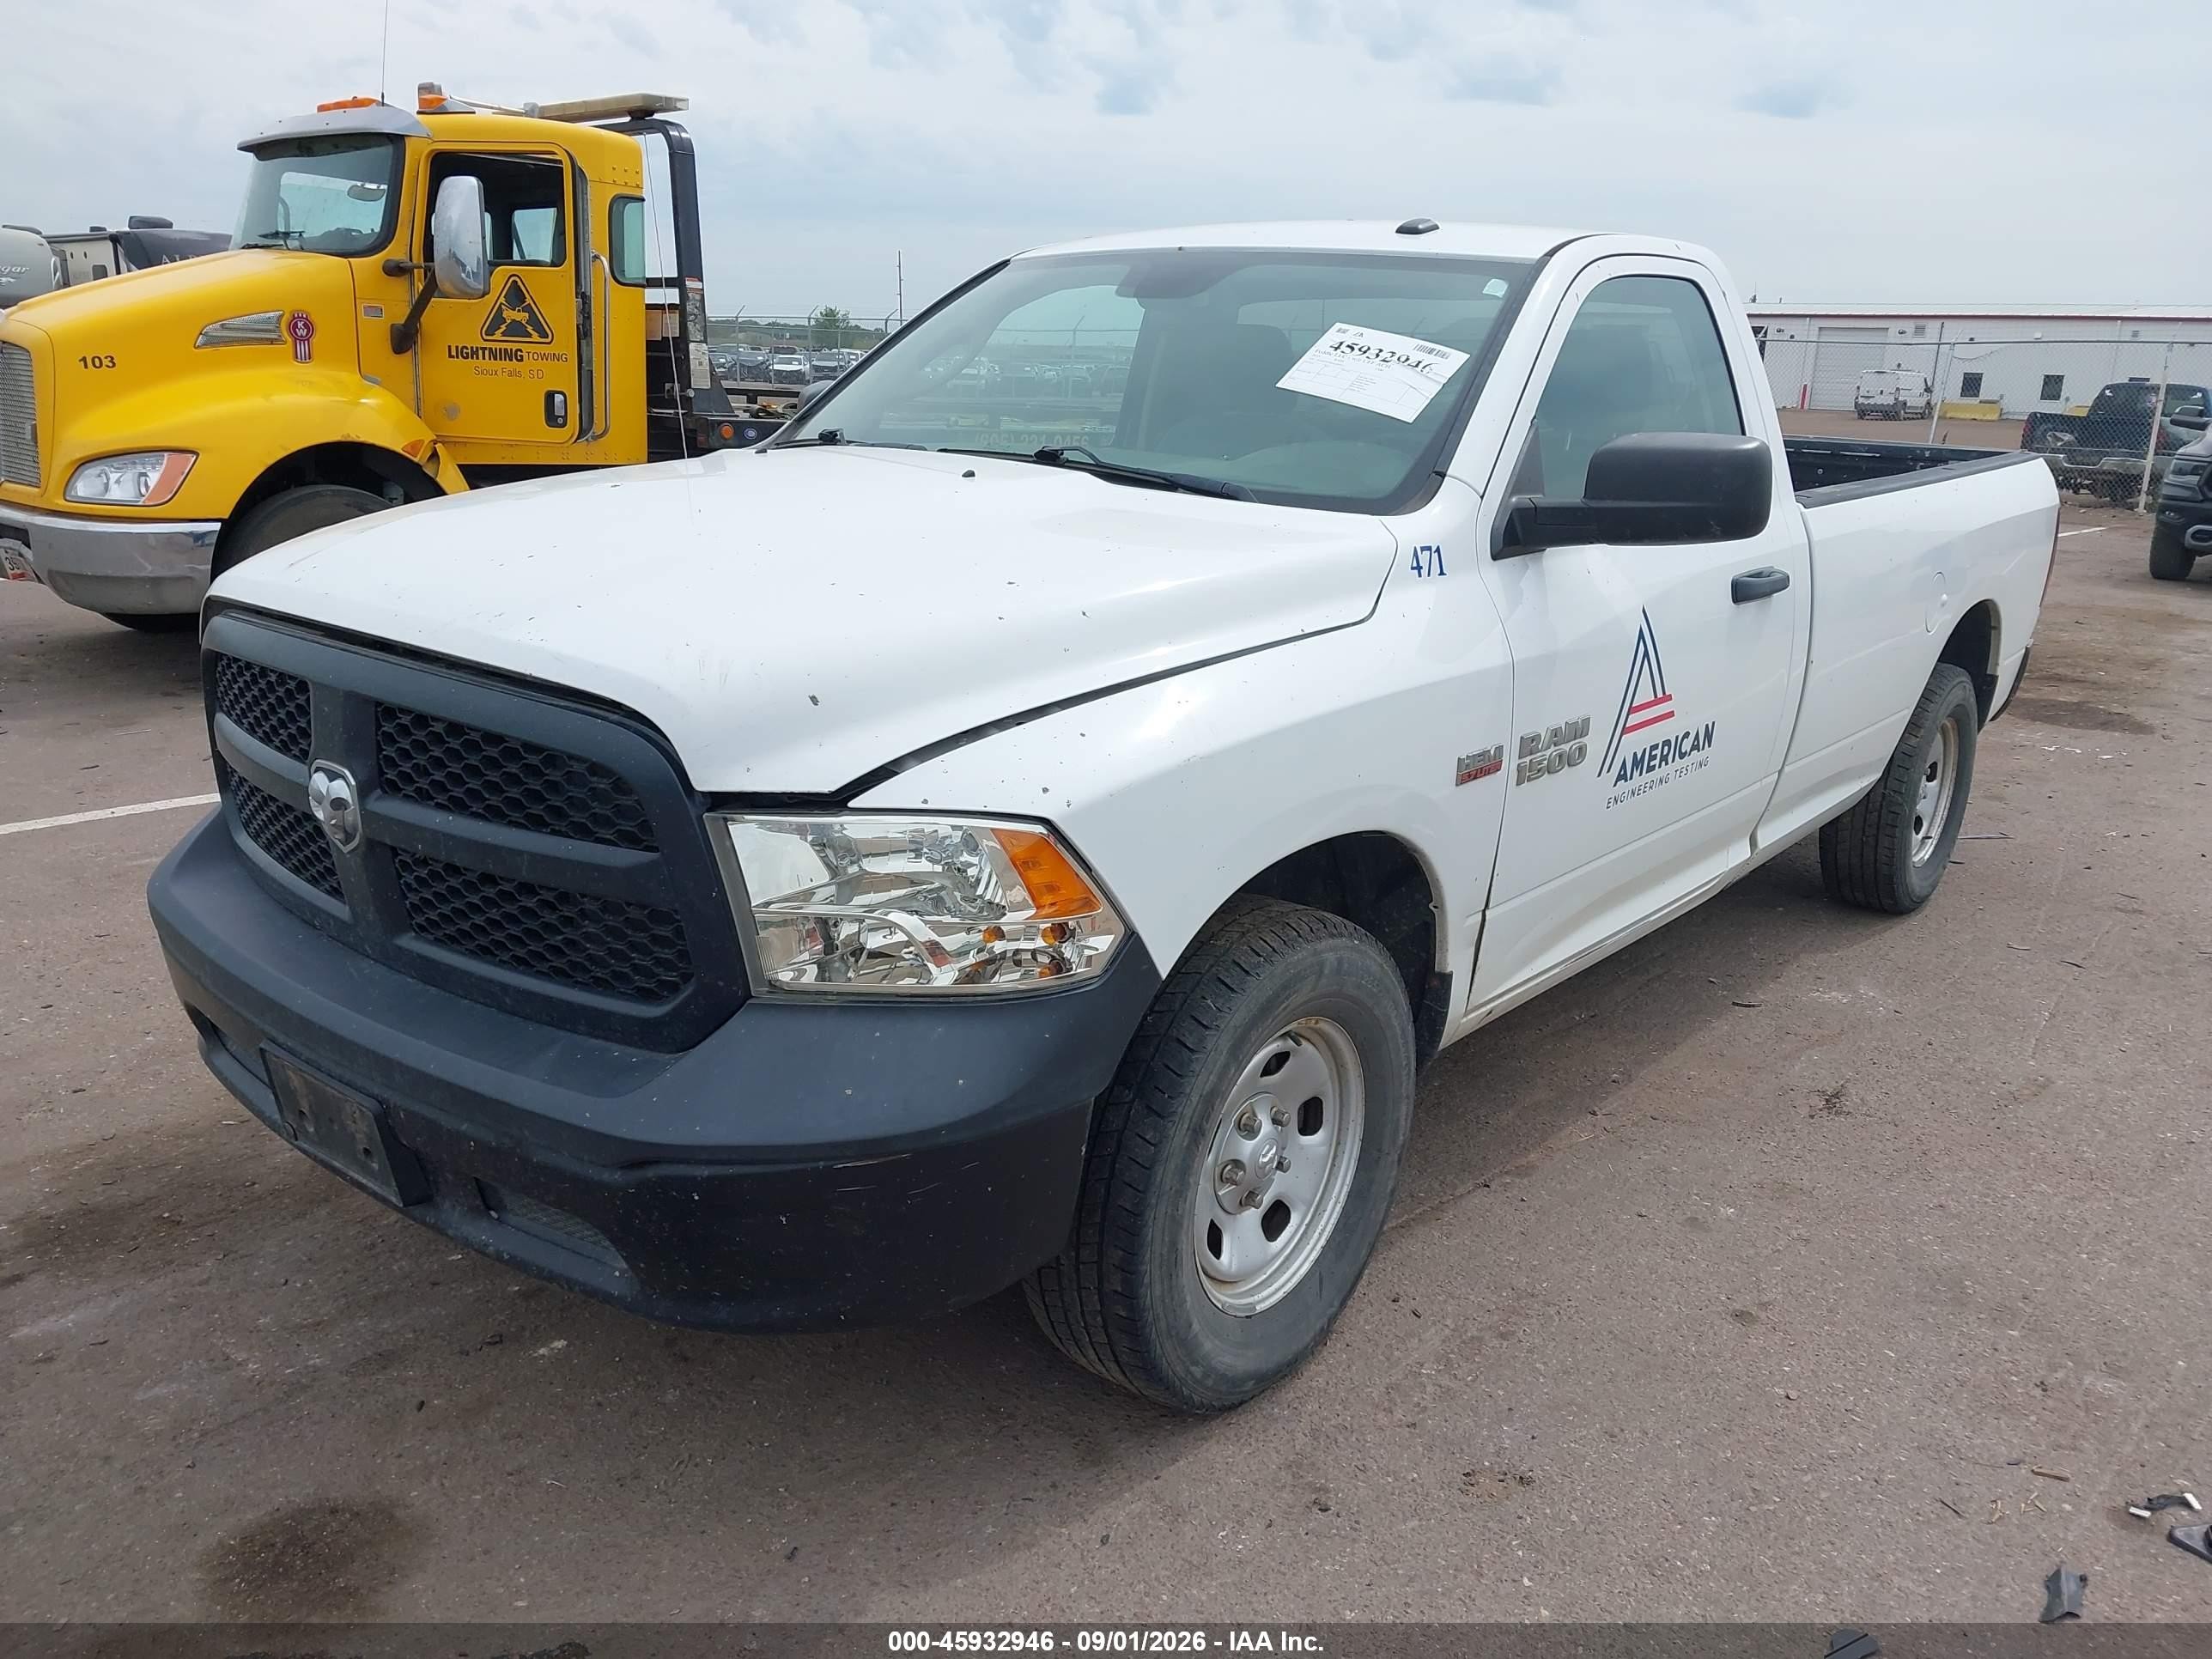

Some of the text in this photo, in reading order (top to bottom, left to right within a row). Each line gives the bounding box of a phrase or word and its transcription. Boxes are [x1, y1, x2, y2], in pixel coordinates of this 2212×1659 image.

[0, 265, 30, 275] gar
[78, 356, 117, 369] 103
[447, 344, 568, 362] LIGHTNING TOWING
[474, 366, 499, 377] Sioux
[528, 369, 544, 379] SD
[1410, 544, 1448, 578] 471
[1518, 714, 1591, 760] RAM
[1613, 721, 1715, 787] AMERICAN
[1516, 742, 1588, 787] 1500
[1606, 756, 1710, 810] ENGINEERING TESTING
